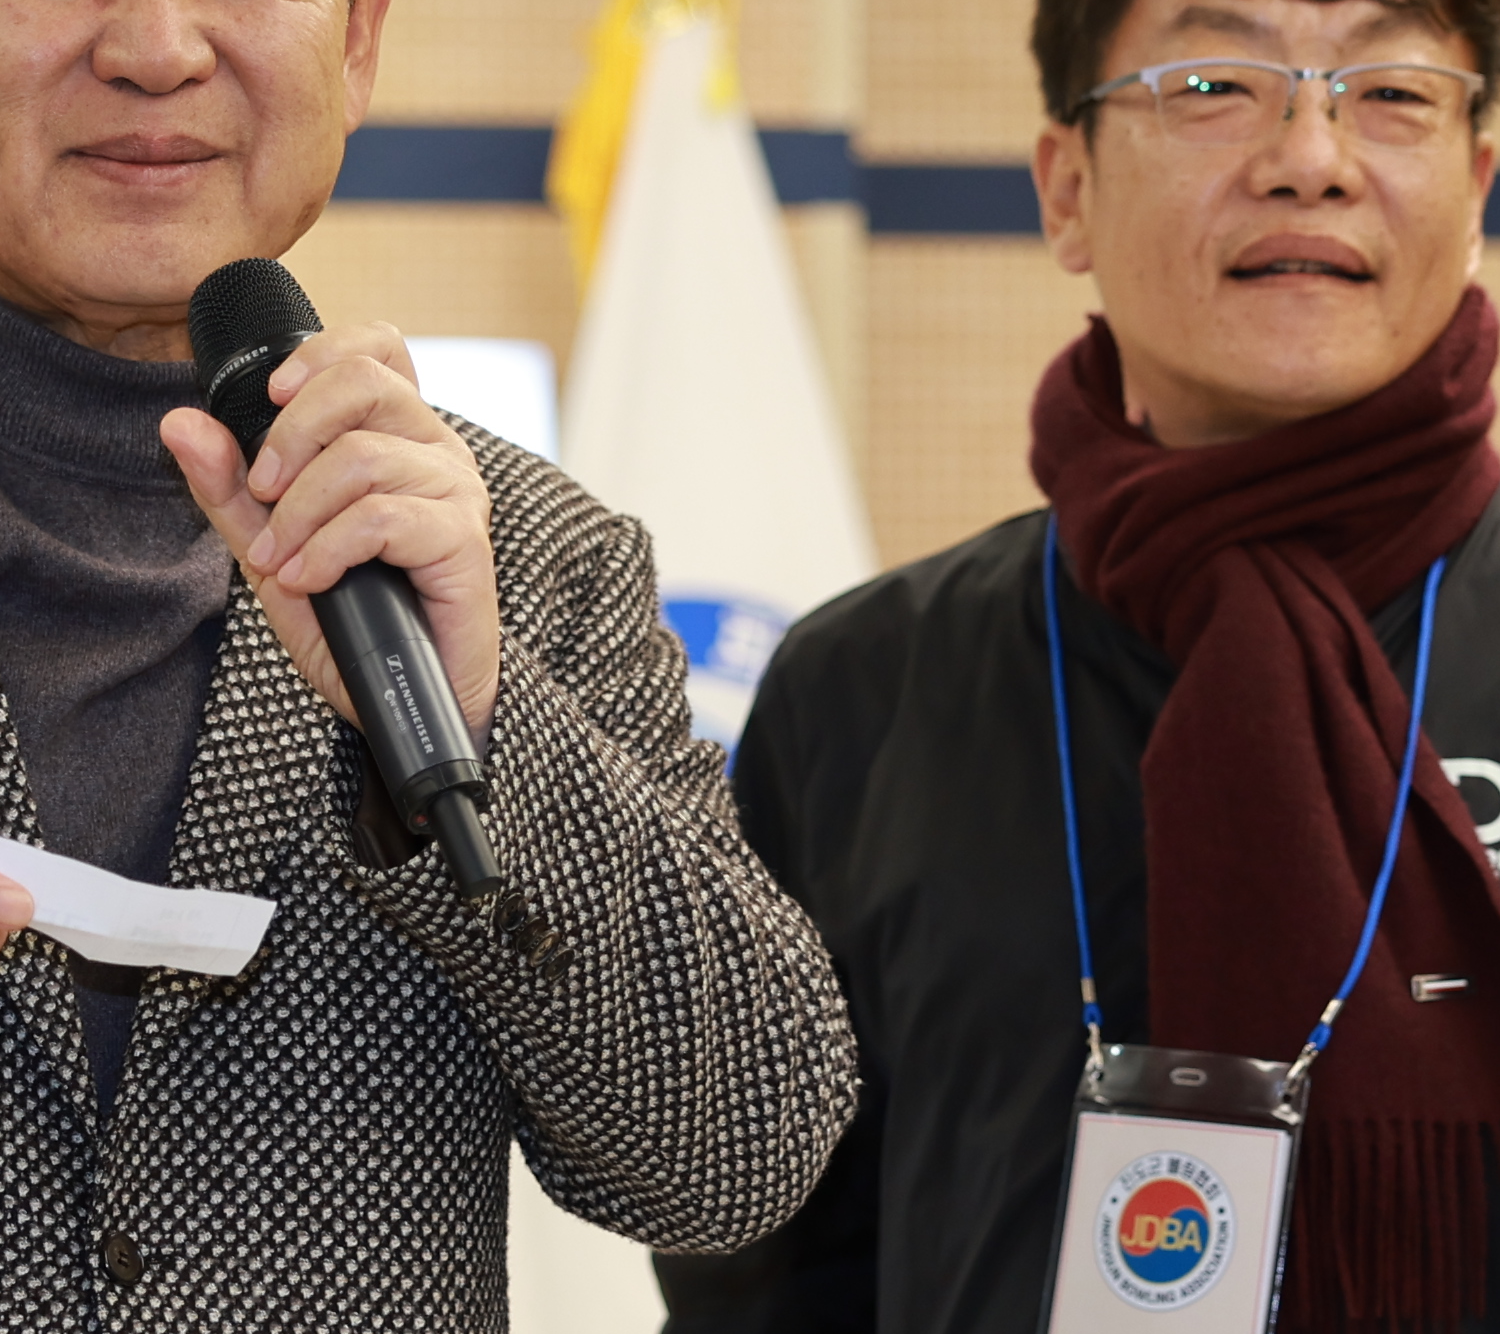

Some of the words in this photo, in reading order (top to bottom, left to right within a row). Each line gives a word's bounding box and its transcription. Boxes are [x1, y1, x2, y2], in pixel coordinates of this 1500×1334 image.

[208, 345, 269, 396] SENNHEISER
[396, 674, 435, 754] SENNHEISER
[1119, 1214, 1203, 1254] JDBA
